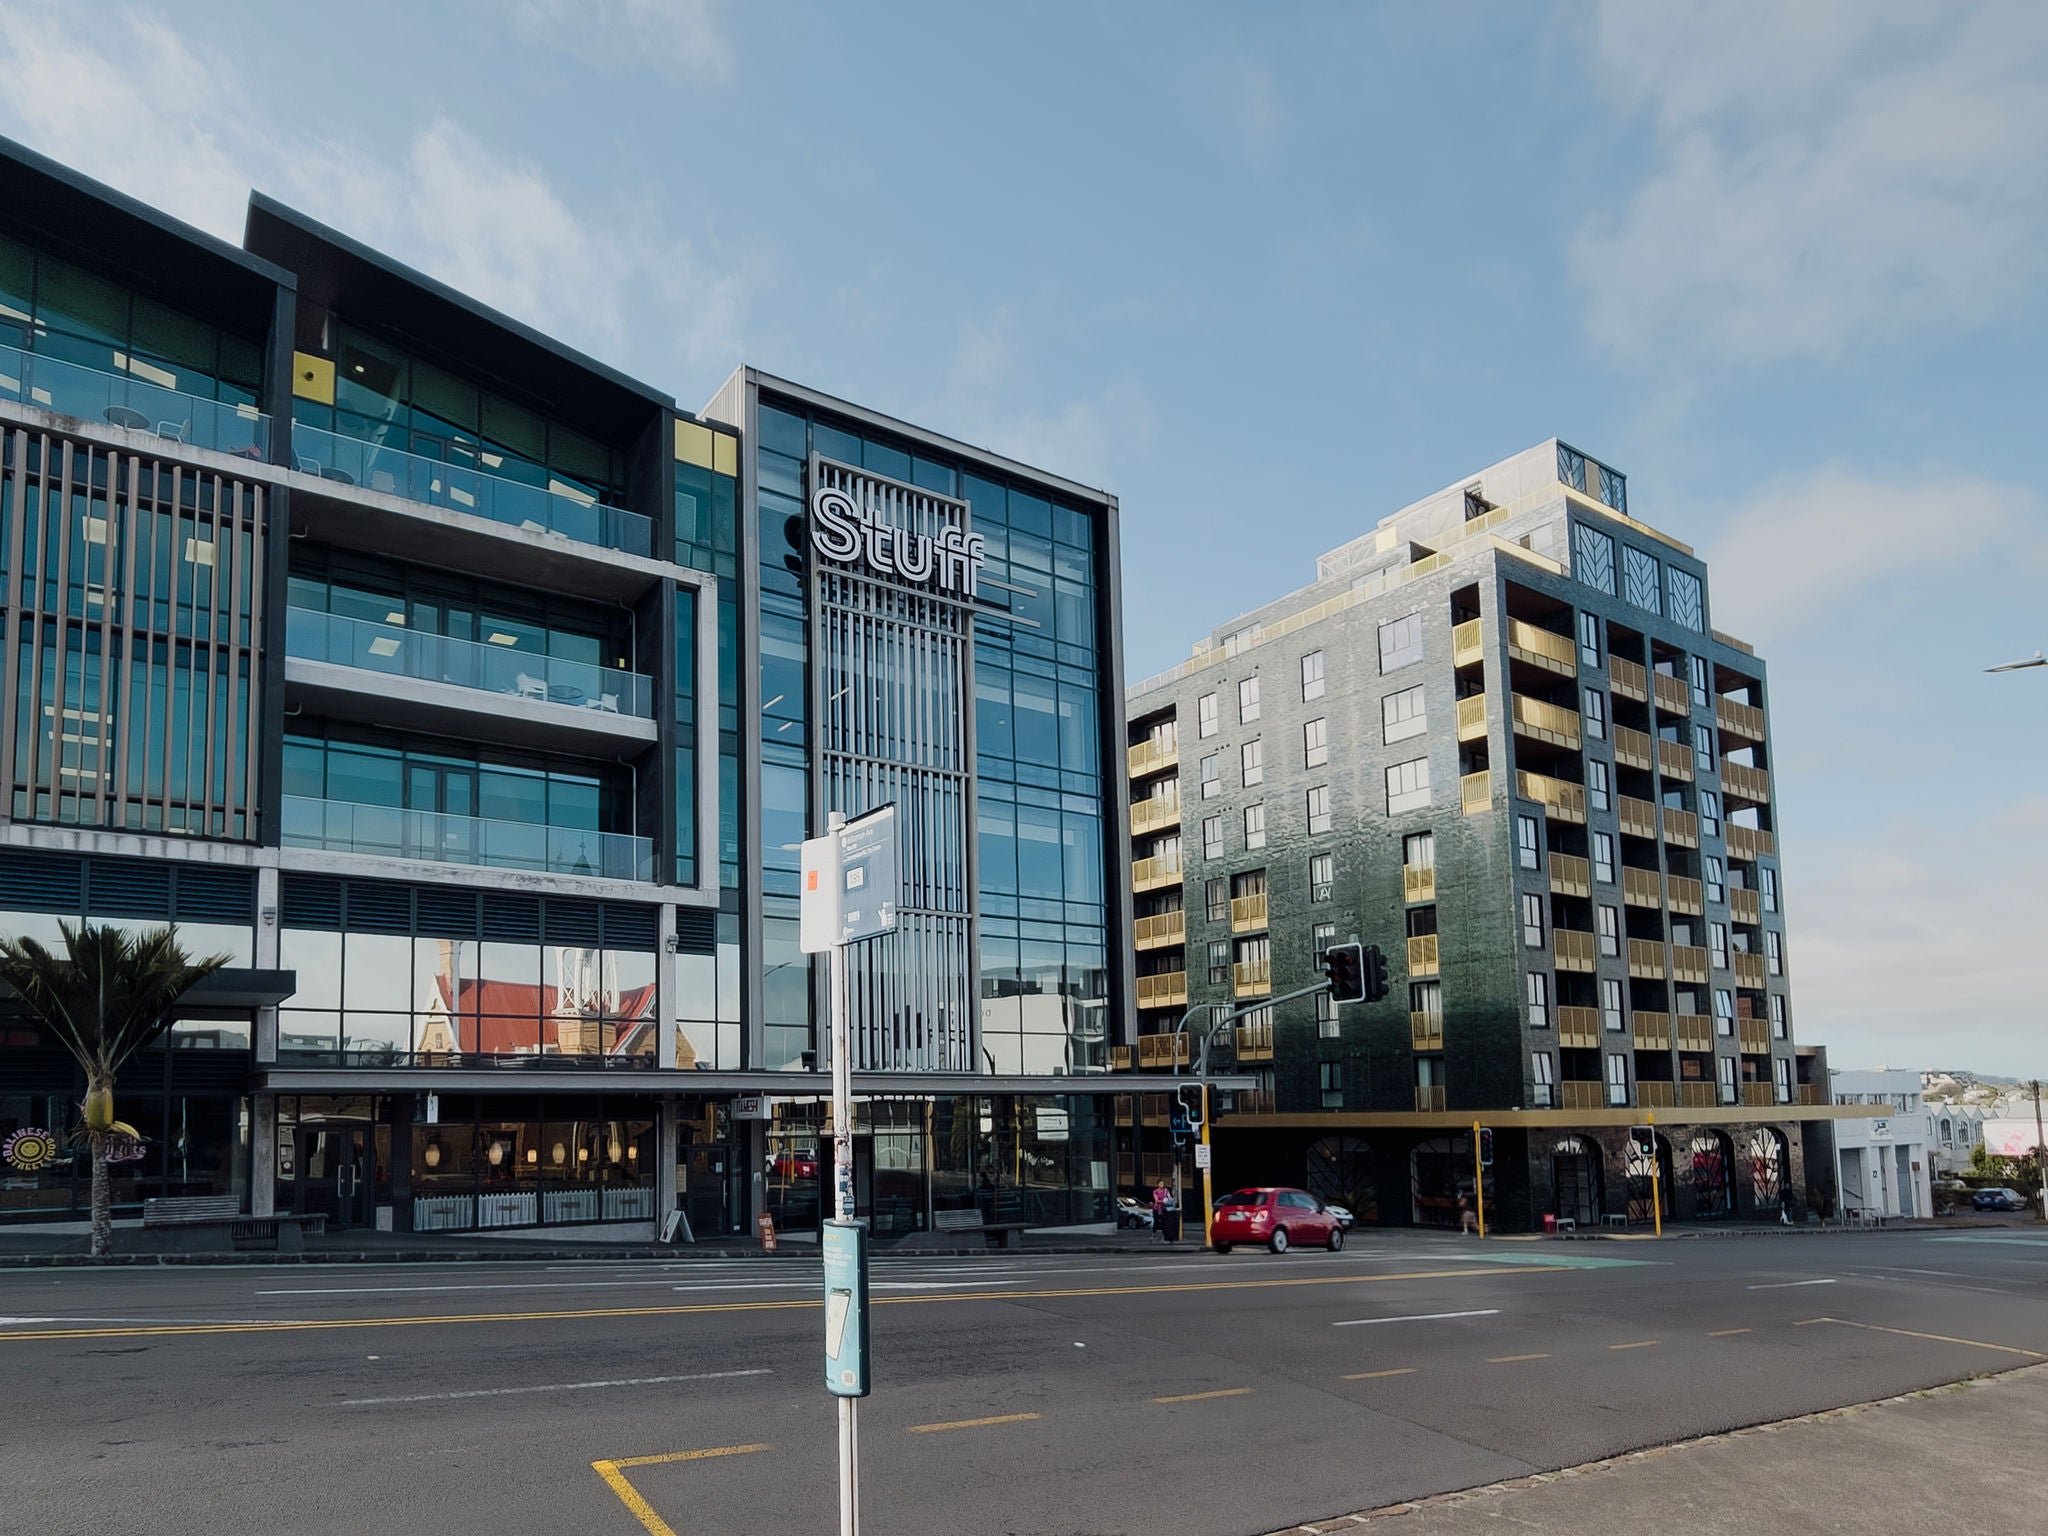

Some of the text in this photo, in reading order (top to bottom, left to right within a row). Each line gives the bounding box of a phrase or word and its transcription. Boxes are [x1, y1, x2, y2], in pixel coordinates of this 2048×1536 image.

[811, 487, 985, 597] Stuff
[2, 1127, 50, 1157] BALINESE
[45, 1138, 56, 1160] FOOD
[6, 1156, 44, 1170] STREET
